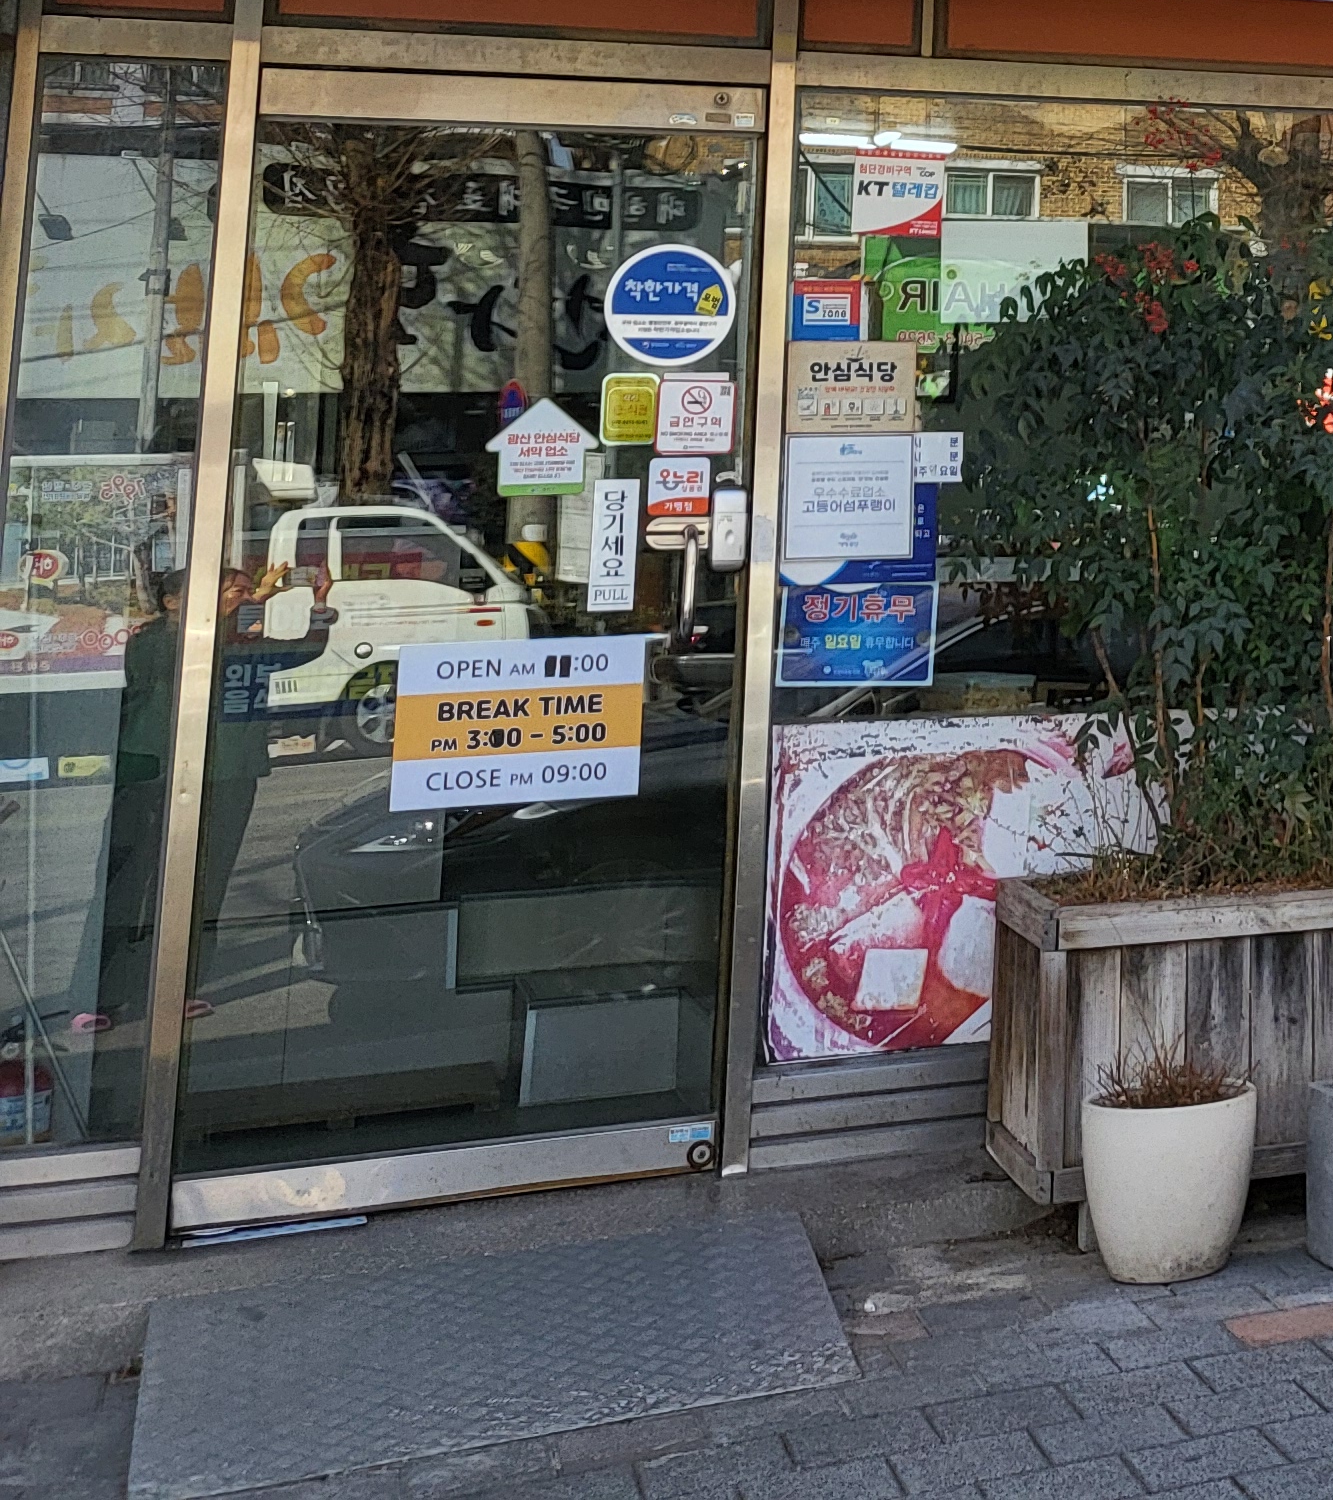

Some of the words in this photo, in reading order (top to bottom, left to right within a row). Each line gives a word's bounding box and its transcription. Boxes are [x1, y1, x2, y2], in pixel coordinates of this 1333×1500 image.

[859, 162, 912, 177] 첨단경비구역
[857, 180, 891, 197] KT
[891, 181, 940, 199] 텔레캅
[623, 278, 700, 303] 착한가격
[805, 299, 821, 315] S
[809, 360, 898, 383] 안심식당
[669, 415, 723, 429] 금연구역
[507, 432, 532, 445] 광산
[545, 445, 569, 458] 업소
[655, 468, 704, 491] 온누리
[663, 501, 693, 512] 가맹점
[802, 498, 896, 514] 고등어섬푸랭이
[601, 490, 629, 578] 당기세요
[593, 588, 629, 603] PULL
[801, 593, 917, 624] 정기휴무
[824, 633, 862, 650] 일요일
[864, 636, 914, 650] 휴무합니다
[436, 658, 502, 680] OPEN
[509, 662, 536, 677] AM
[436, 697, 531, 722] BREAK
[538, 693, 604, 716] TIME
[430, 737, 458, 752] PM
[551, 722, 607, 745] 5:00
[426, 768, 502, 792] CLOSE
[510, 772, 534, 787] PM
[541, 761, 608, 784] 09:00
